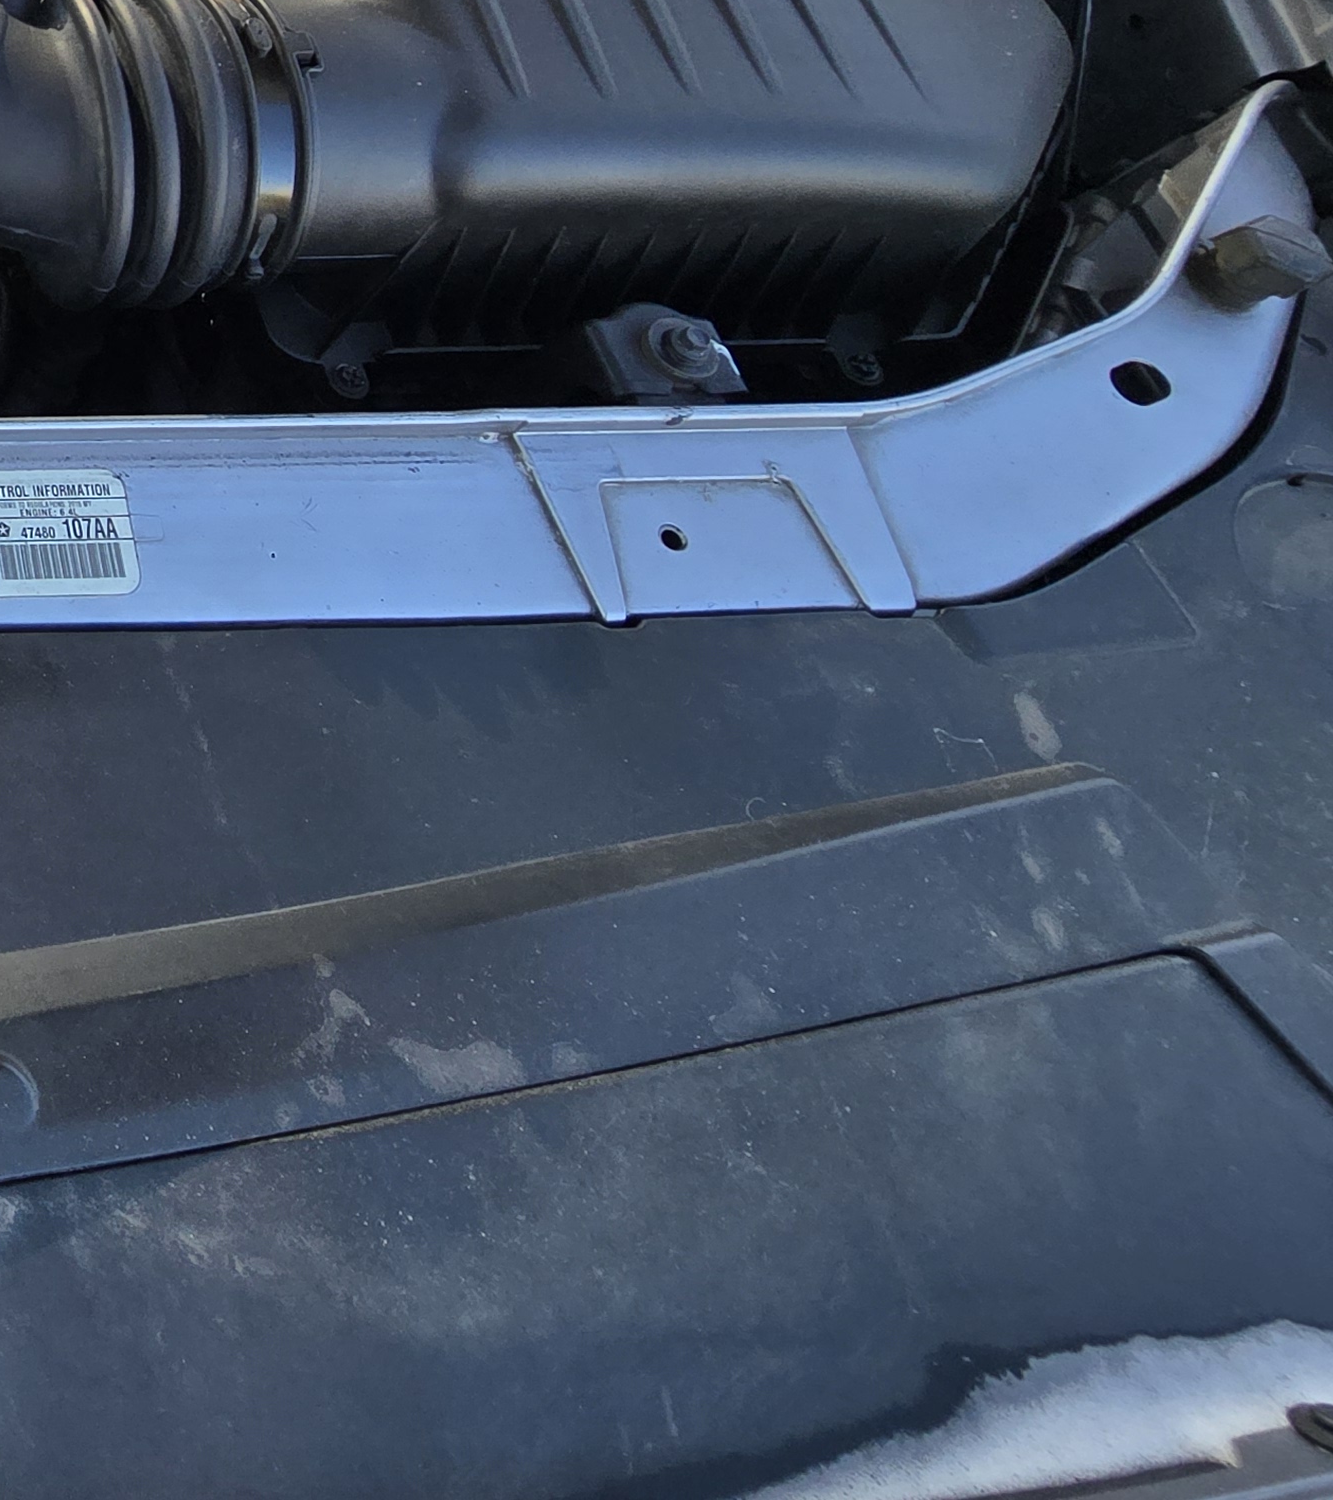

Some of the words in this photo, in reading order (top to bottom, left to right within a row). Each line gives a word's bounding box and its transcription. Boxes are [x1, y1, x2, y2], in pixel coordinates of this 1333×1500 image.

[33, 483, 111, 497] INFORMATION
[19, 509, 56, 517] ENGINE:
[21, 527, 56, 538] 47480
[62, 518, 119, 539] 107AA
